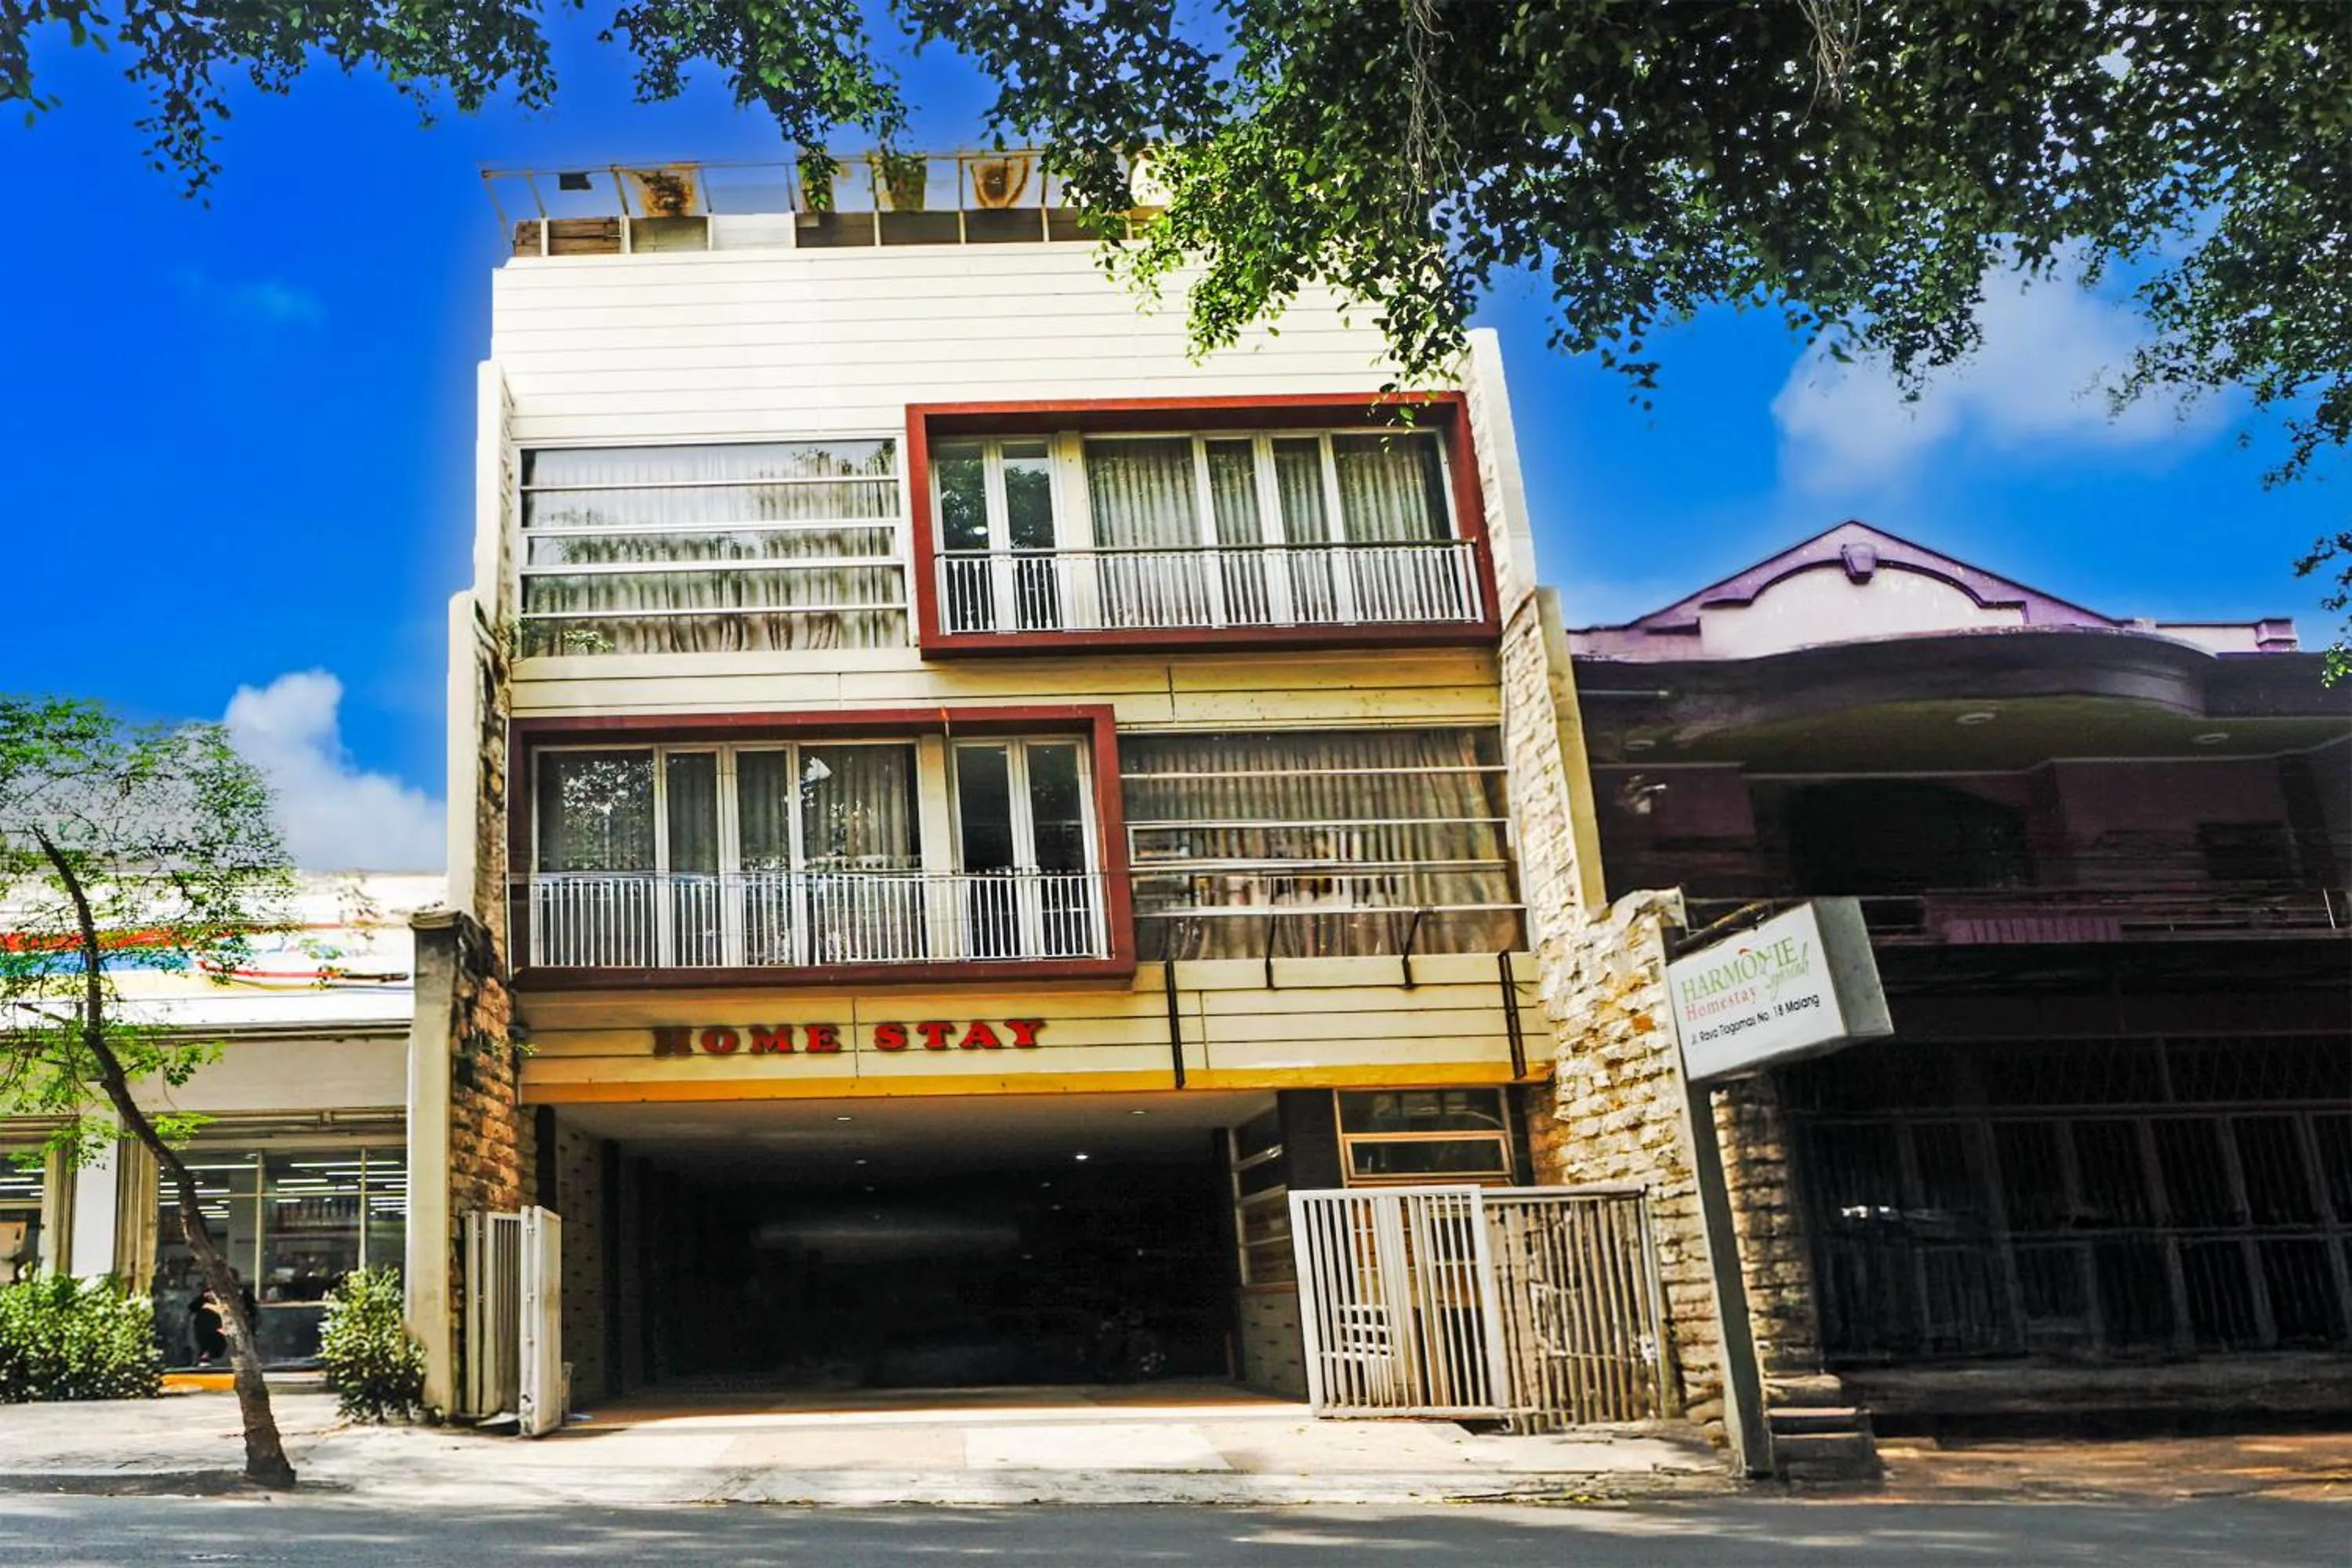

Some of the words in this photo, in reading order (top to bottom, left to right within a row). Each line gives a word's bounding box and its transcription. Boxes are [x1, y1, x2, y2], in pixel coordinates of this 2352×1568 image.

[1680, 937, 1799, 1004] HARMONIE
[1684, 986, 1757, 1022] Homestay
[1784, 994, 1820, 1014] Malang
[653, 1024, 842, 1059] HOME
[873, 1018, 1047, 1051] STAY
